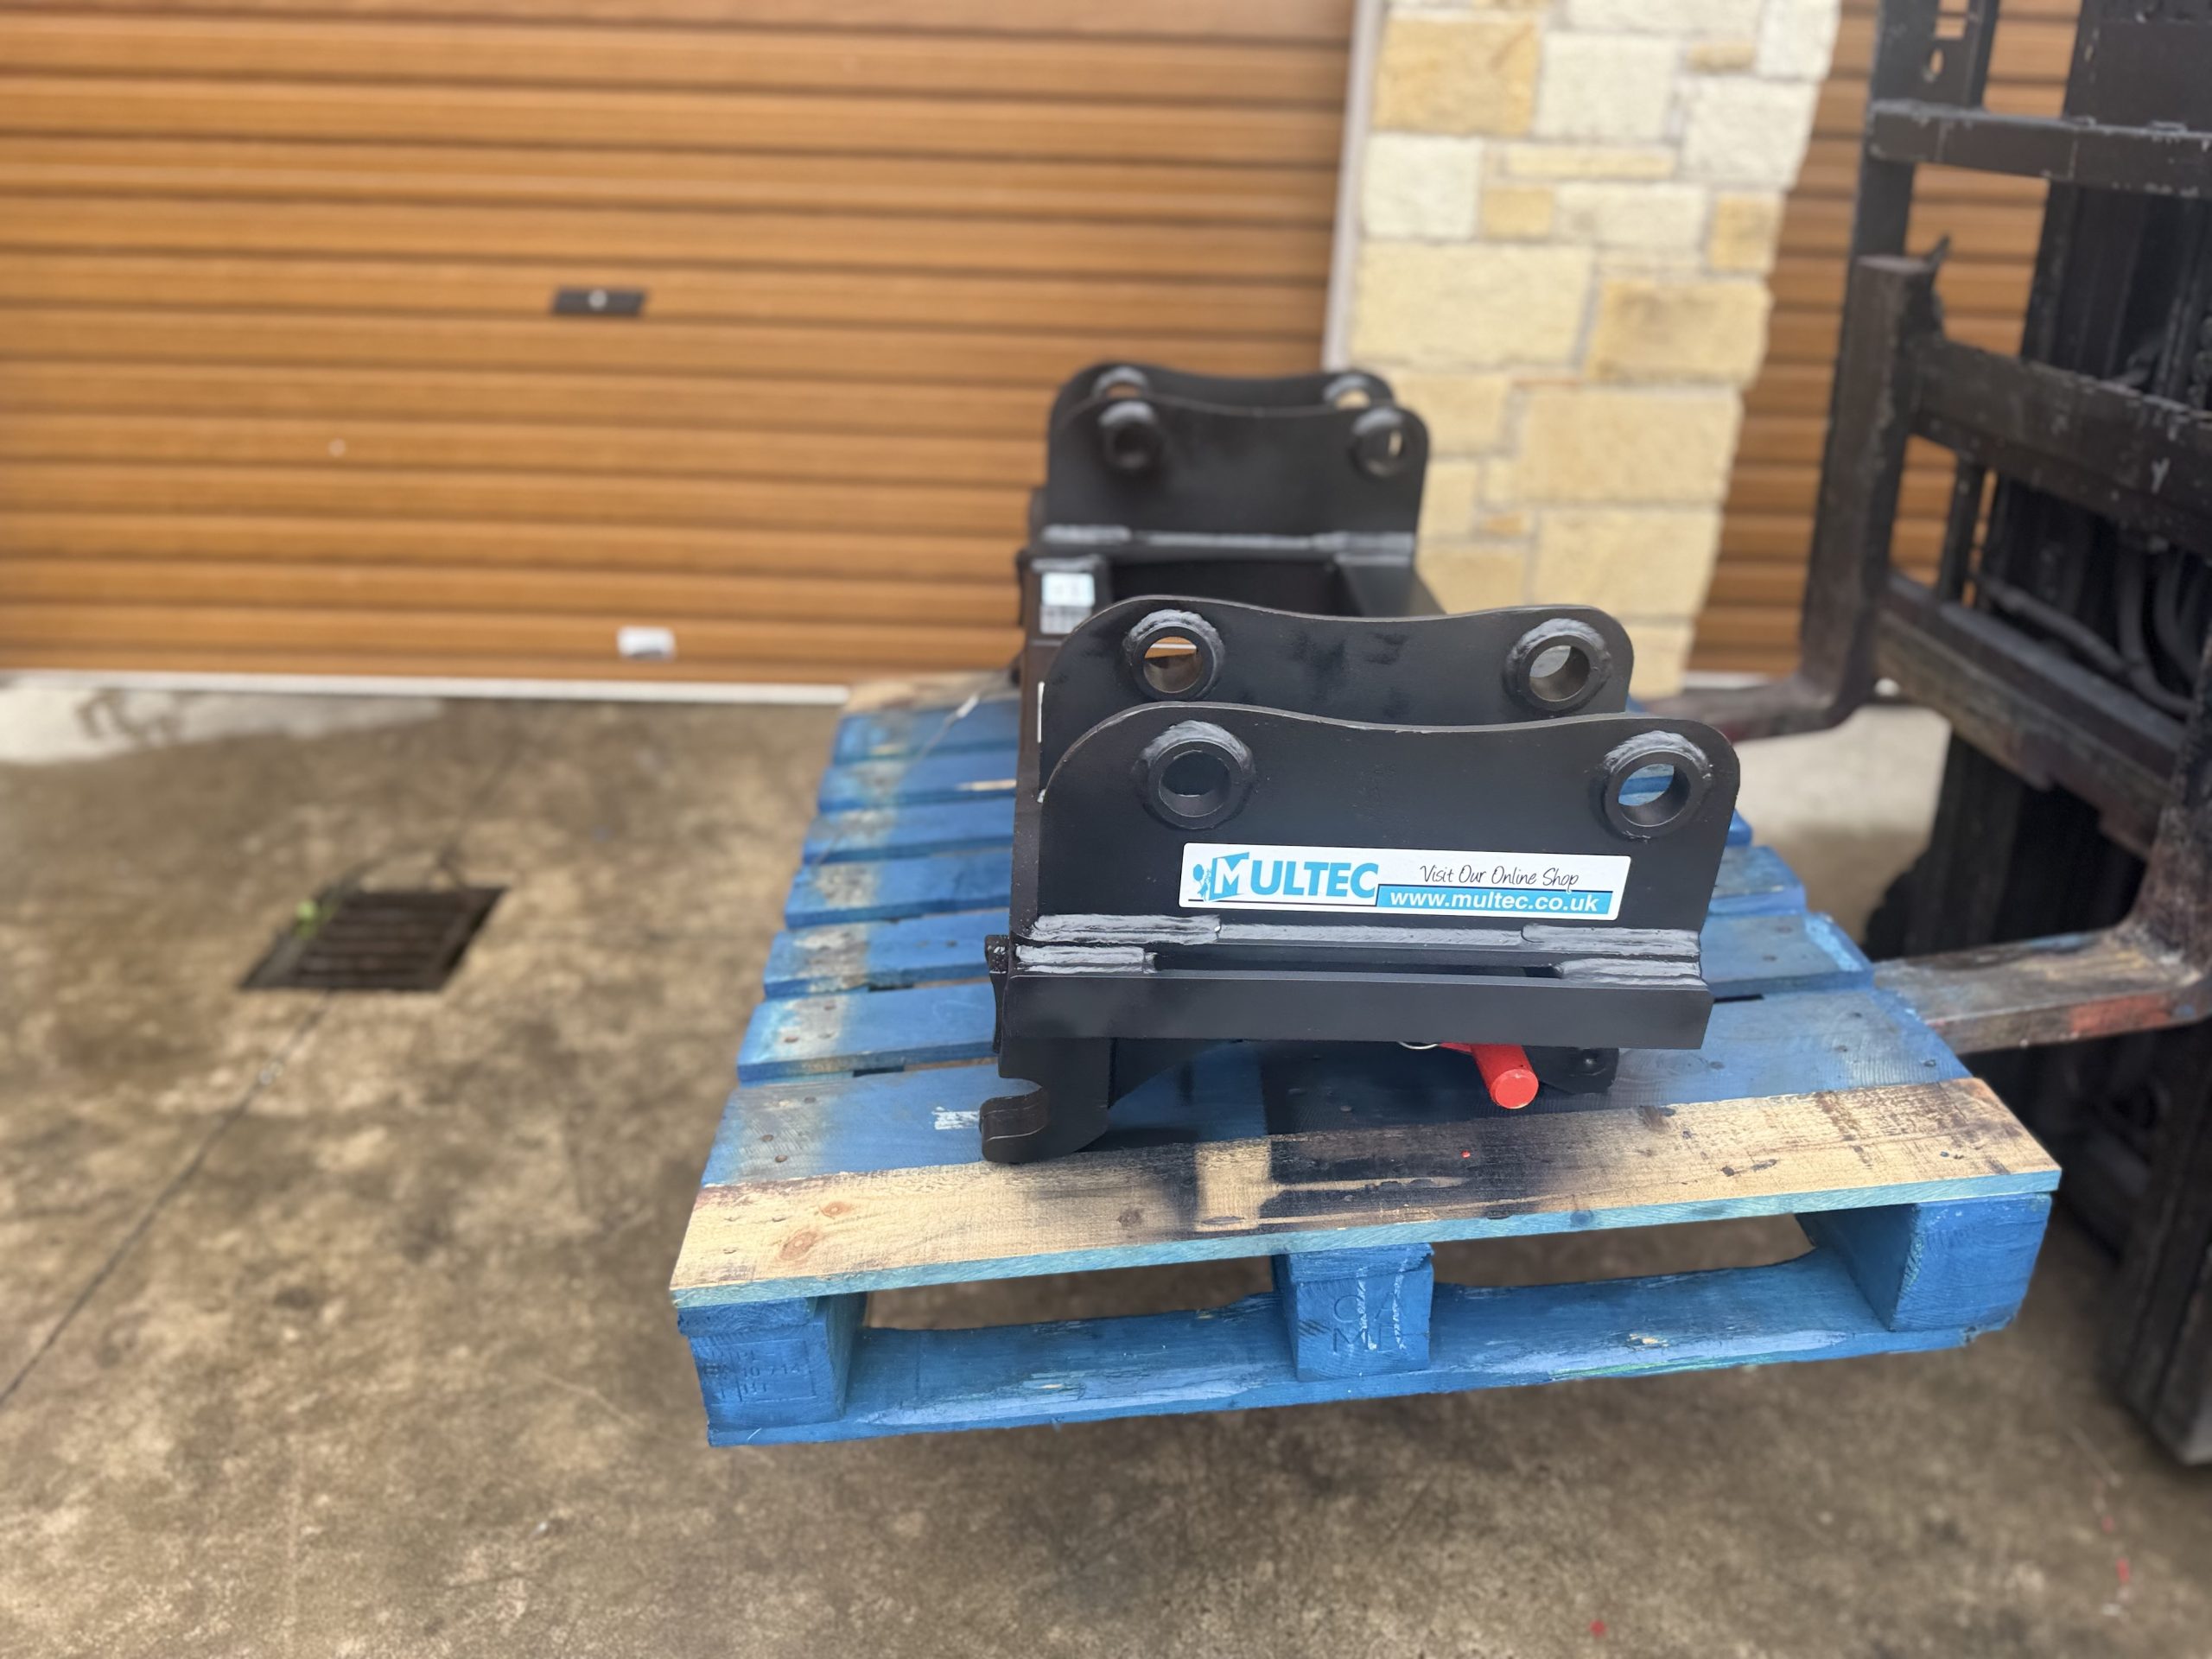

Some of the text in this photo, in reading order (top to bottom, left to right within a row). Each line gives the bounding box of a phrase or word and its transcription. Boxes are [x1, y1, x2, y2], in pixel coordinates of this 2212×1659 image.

[1209, 852, 1379, 901] MULTEC
[1420, 864, 1580, 894] Visit Our Online Shop
[1390, 891, 1599, 912] www.multec.co.uk
